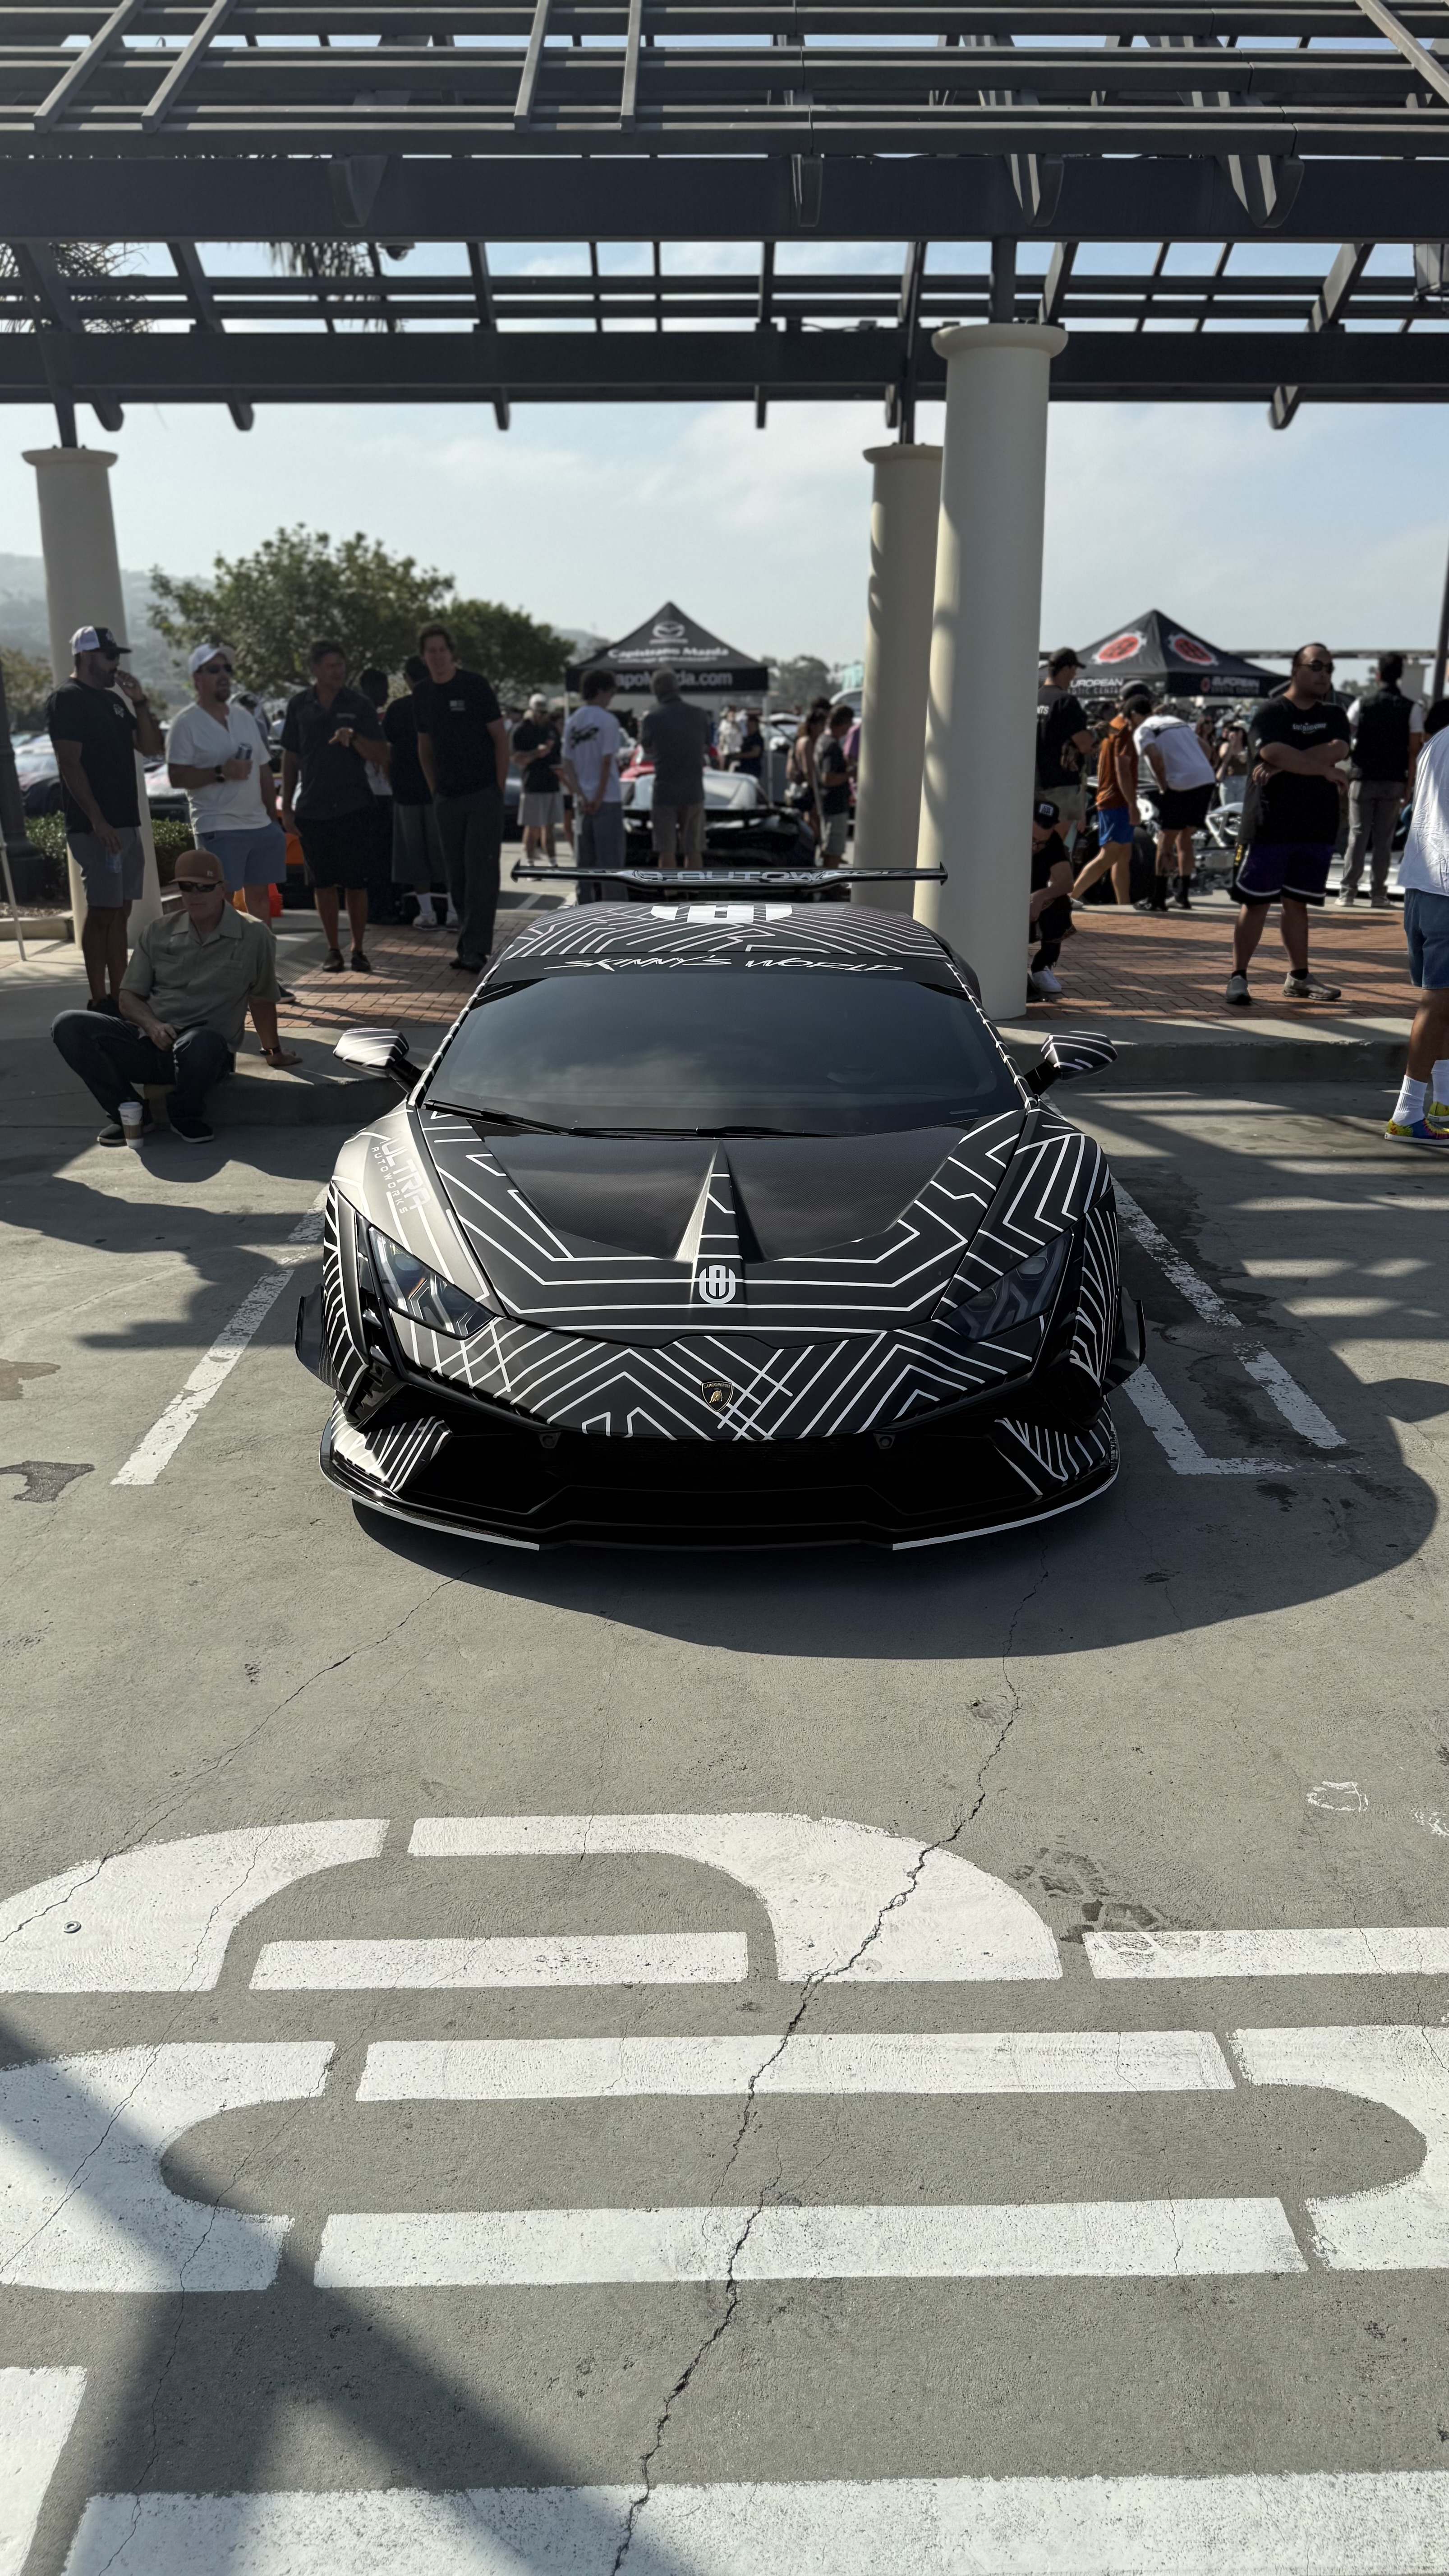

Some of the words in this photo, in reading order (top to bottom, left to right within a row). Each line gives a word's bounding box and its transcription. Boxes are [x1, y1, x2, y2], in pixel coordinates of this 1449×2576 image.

[1070, 678, 1123, 687] UROPEAN
[745, 958, 903, 971] WORLD
[371, 1146, 409, 1214] AUTOWORKS
[380, 1135, 431, 1210] ULTRA
